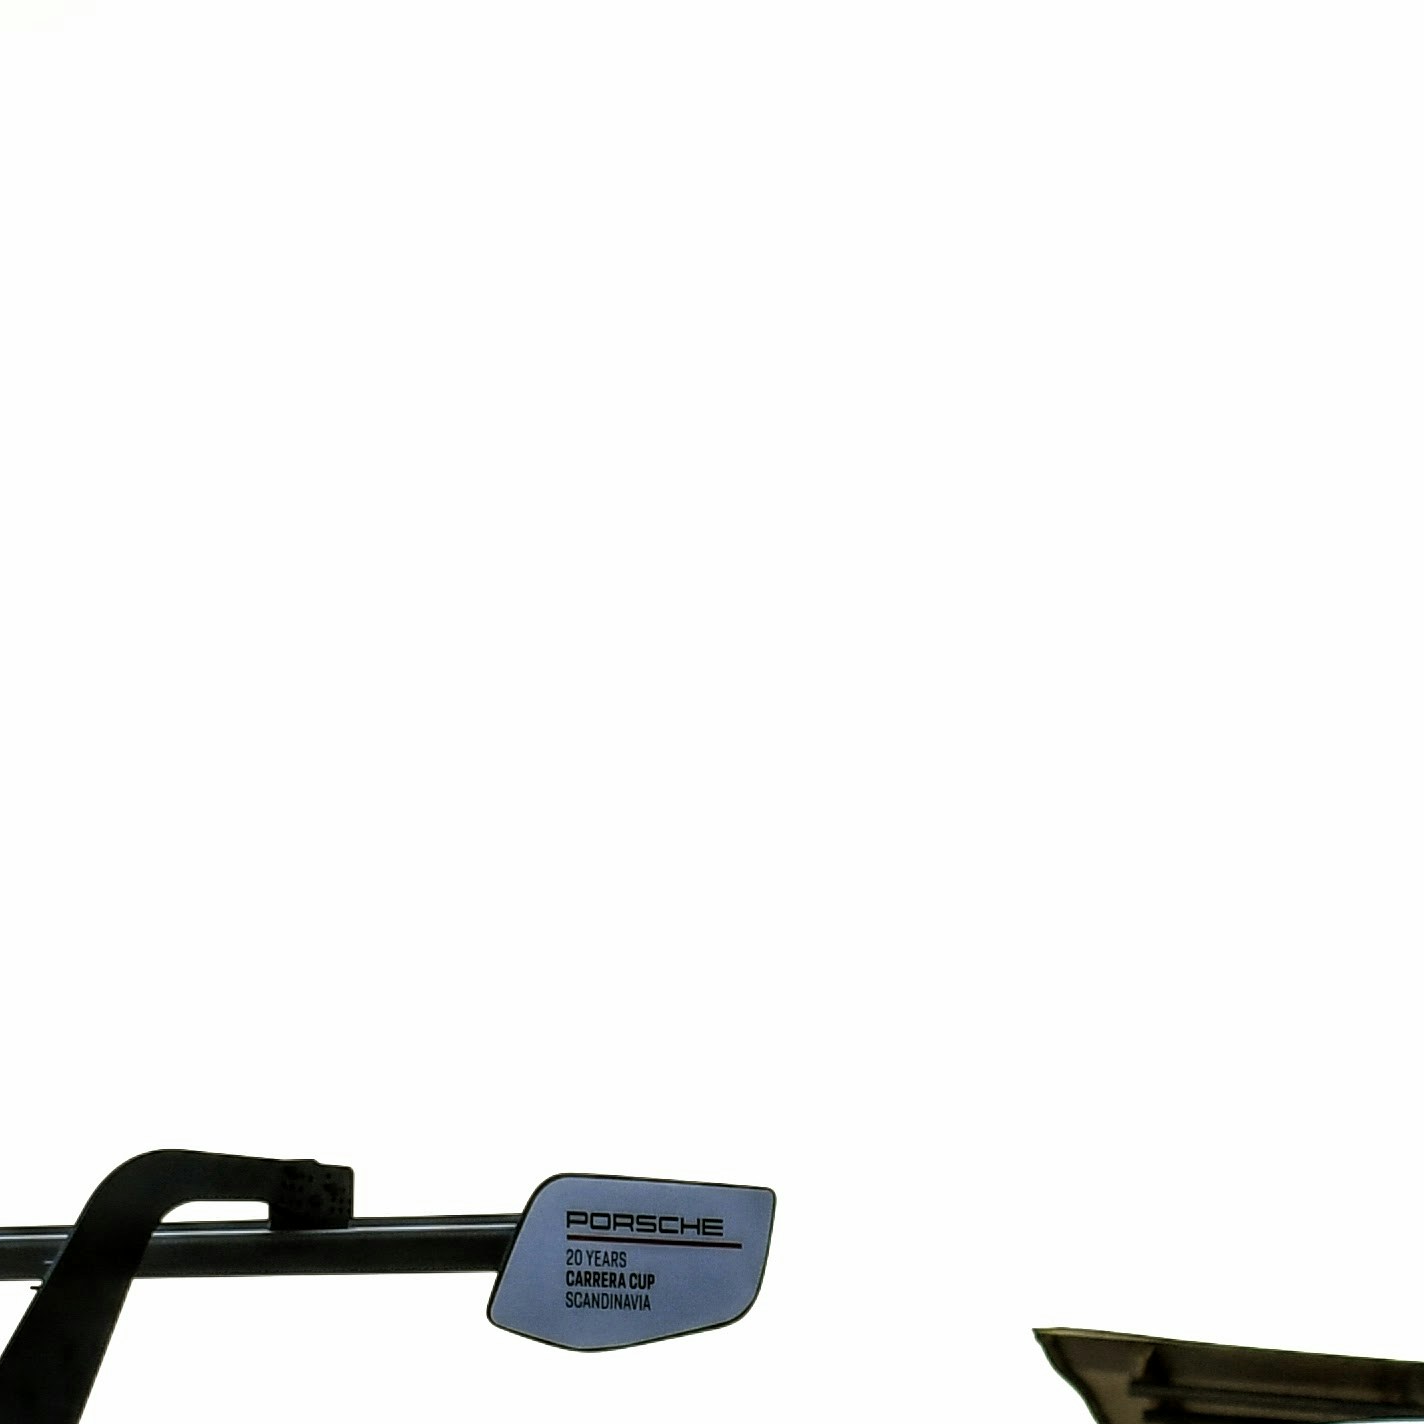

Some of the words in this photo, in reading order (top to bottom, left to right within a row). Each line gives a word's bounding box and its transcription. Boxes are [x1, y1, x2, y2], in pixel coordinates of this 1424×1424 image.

[566, 1211, 724, 1236] PORSCHE
[566, 1249, 583, 1267] 20
[586, 1250, 628, 1269] YEARS
[566, 1270, 626, 1290] CARRERA
[629, 1273, 655, 1291] CUP
[565, 1291, 651, 1312] SCANDINAVIA
